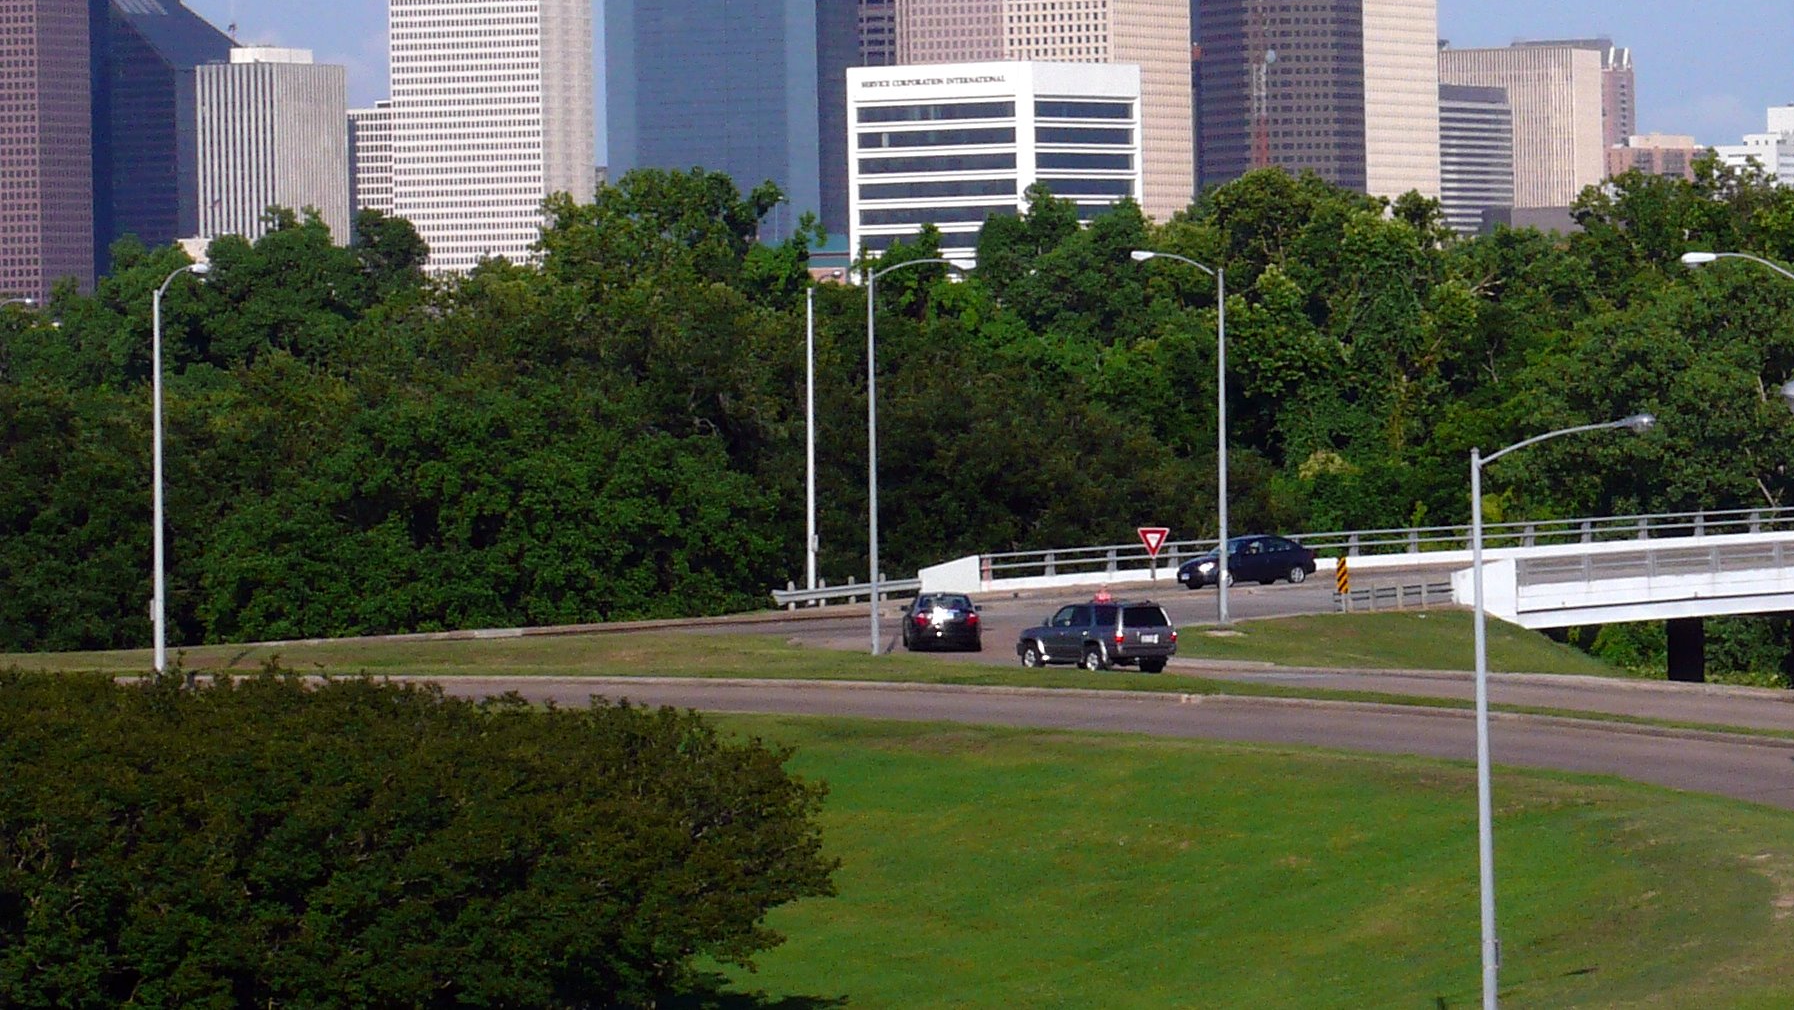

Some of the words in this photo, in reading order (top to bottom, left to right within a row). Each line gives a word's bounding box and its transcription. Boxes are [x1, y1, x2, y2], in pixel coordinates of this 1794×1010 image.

[861, 80, 890, 88] SERVICE
[892, 78, 944, 87] CORPORATION
[946, 75, 1005, 85] INTERNATIONAL
